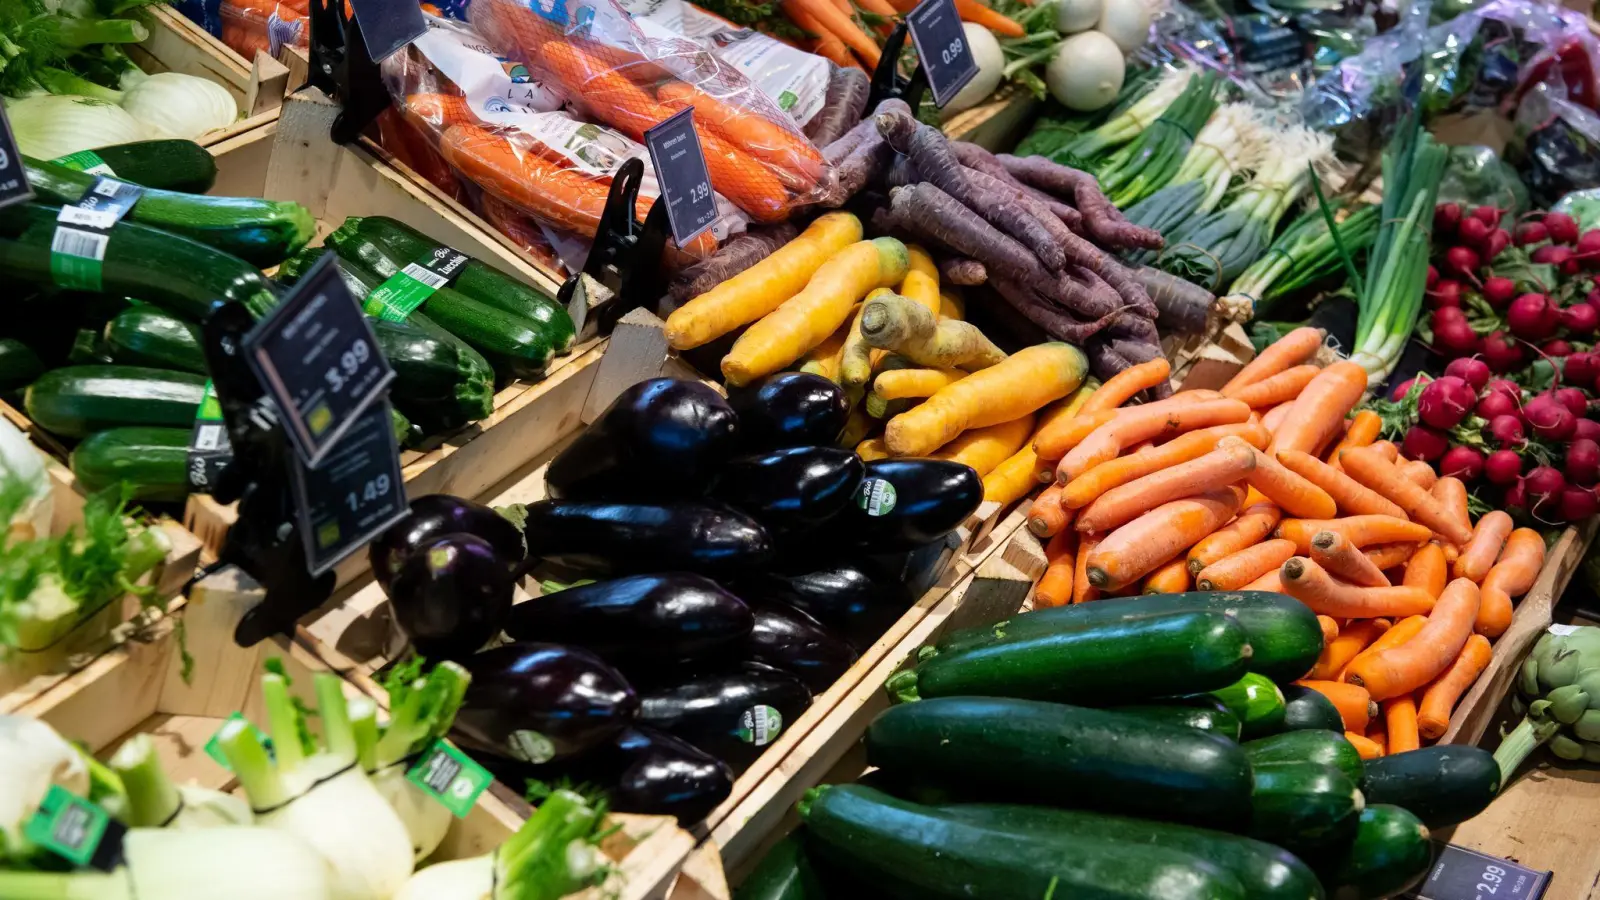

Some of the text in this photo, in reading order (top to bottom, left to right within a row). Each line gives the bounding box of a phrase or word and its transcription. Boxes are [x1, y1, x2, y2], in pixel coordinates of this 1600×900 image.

[942, 38, 963, 64] 0.99
[690, 182, 709, 204] 2.99
[434, 247, 451, 259] Bio
[437, 254, 468, 275] Zucchini
[324, 338, 369, 393] 3.99
[190, 456, 208, 486] Bio
[345, 473, 391, 513] 1.49
[863, 481, 871, 496] Bio
[744, 711, 754, 729] Bio
[1476, 865, 1507, 895] 2.99
